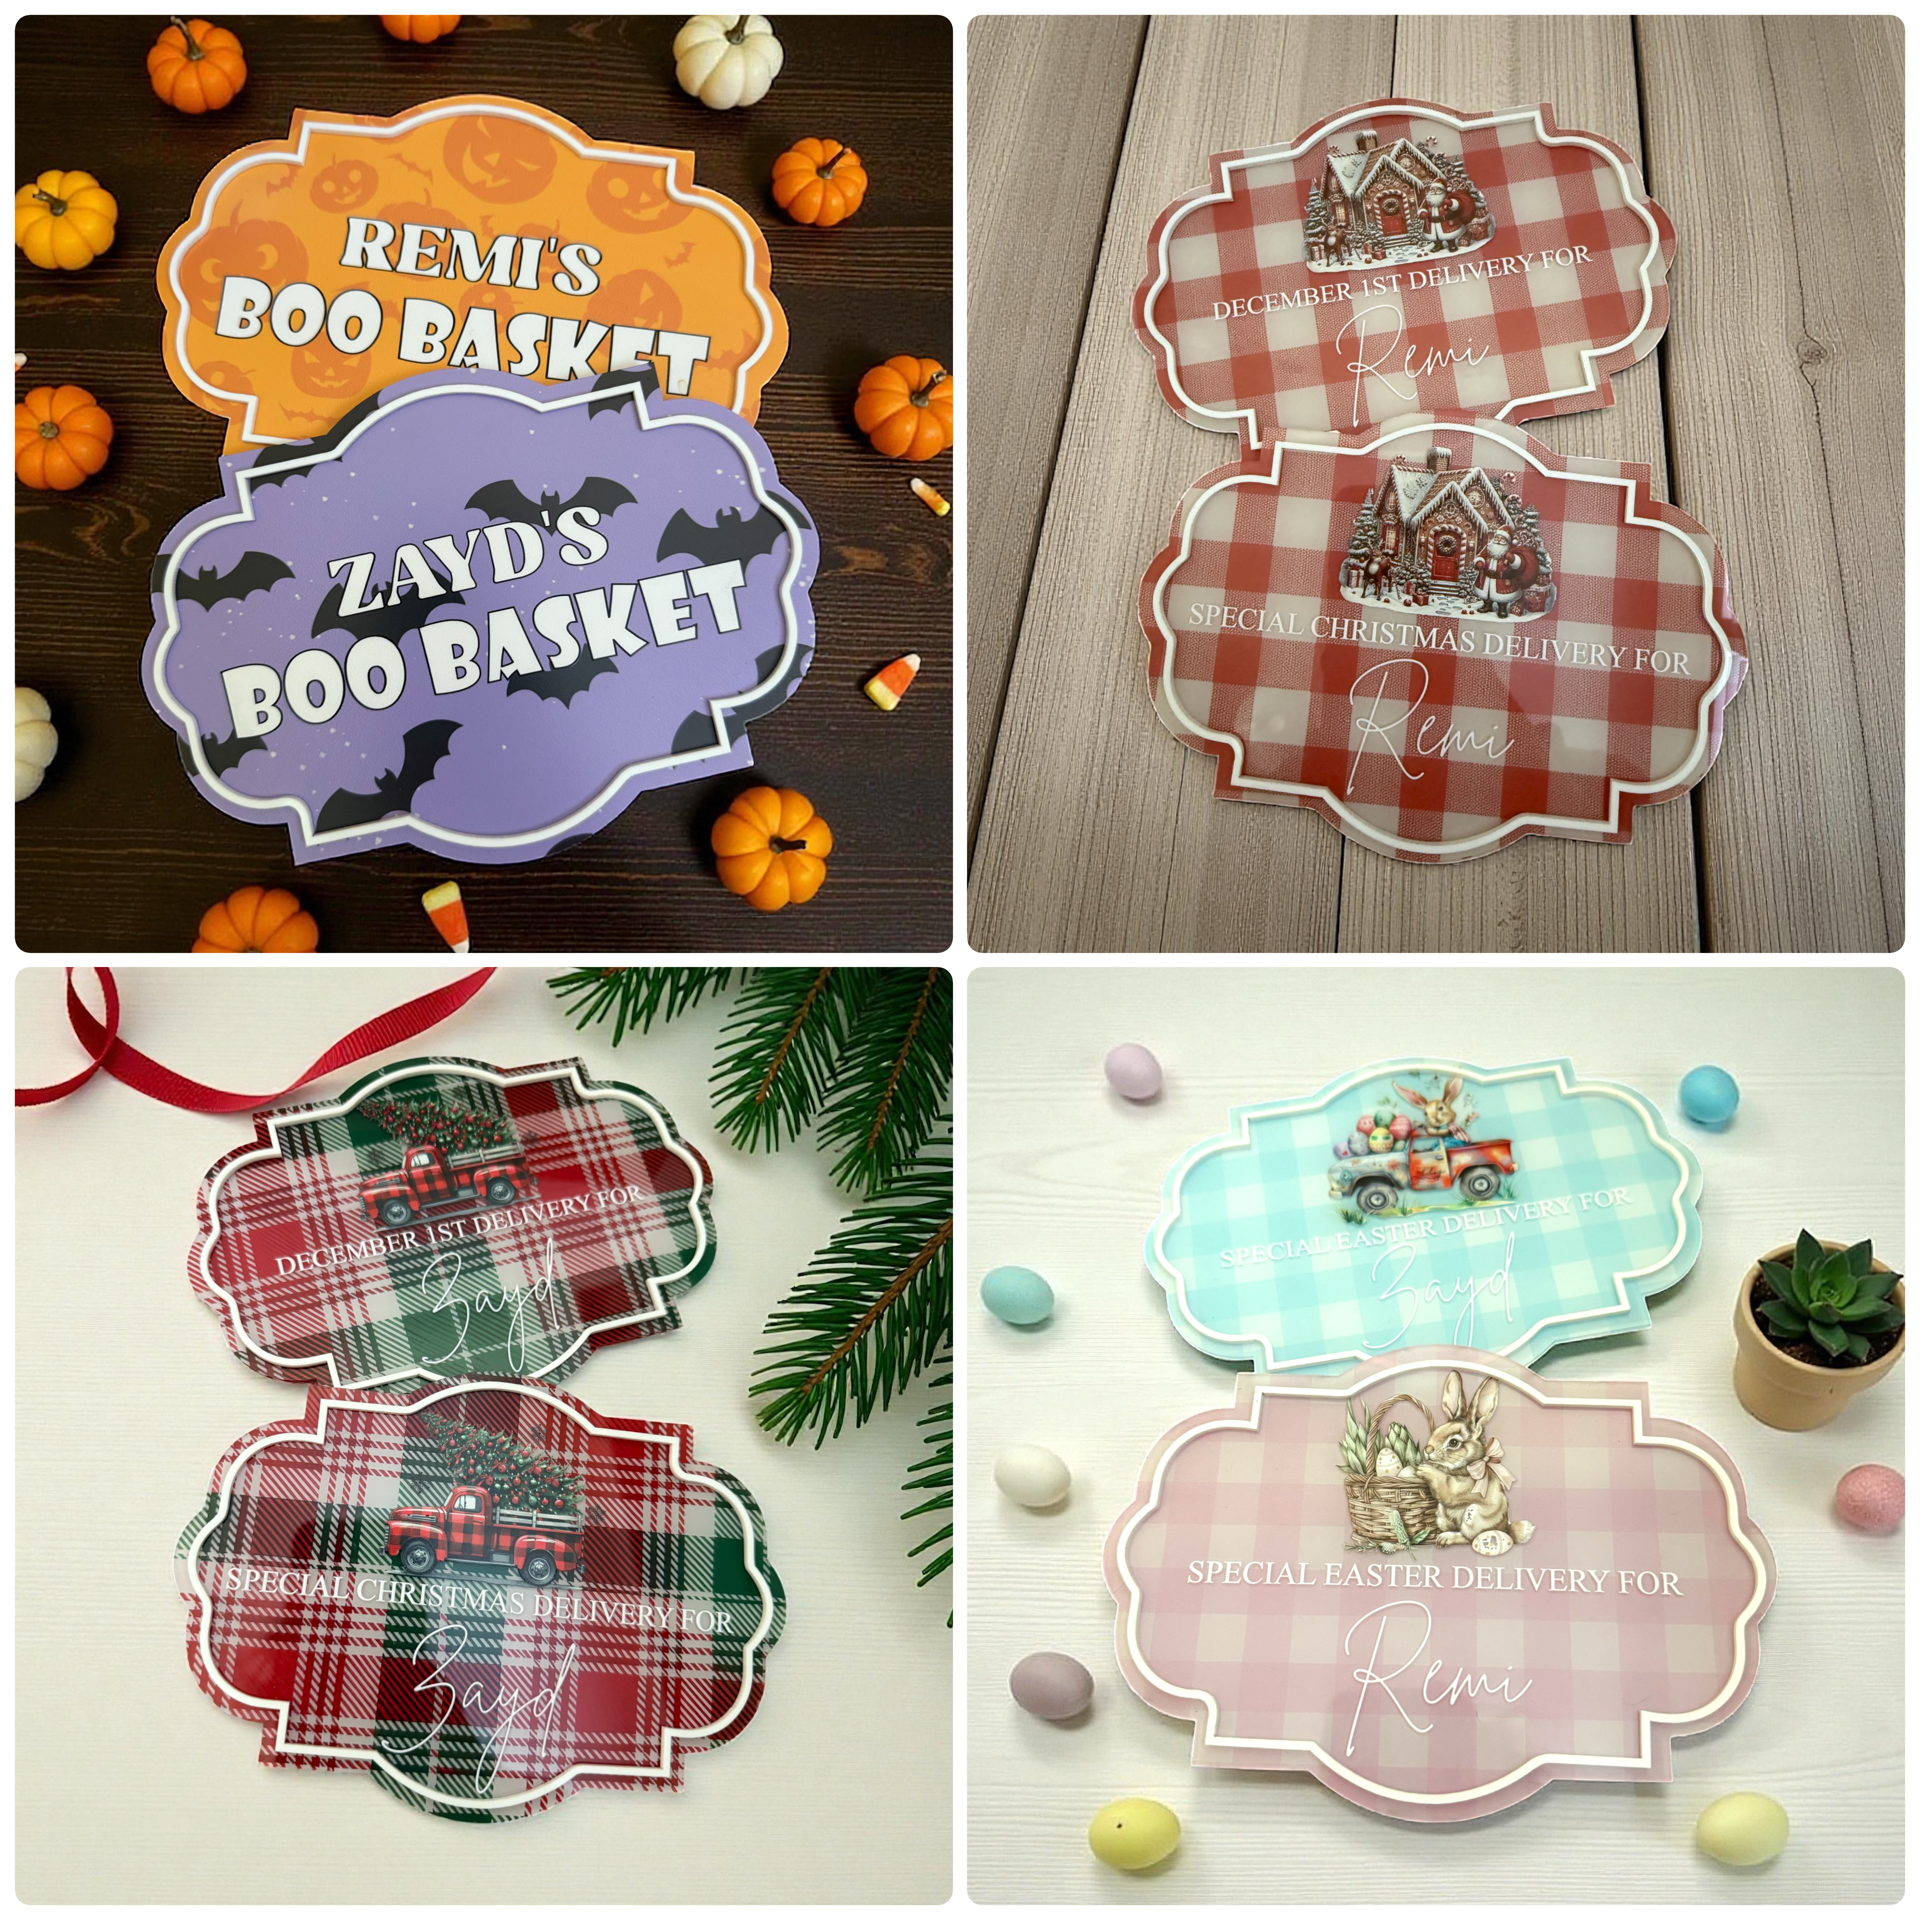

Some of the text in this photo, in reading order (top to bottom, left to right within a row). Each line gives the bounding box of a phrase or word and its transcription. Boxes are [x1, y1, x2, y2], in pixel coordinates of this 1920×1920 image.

[339, 216, 603, 297] REMI'S
[1212, 245, 1592, 320] DECEMBER 1ST DELIVERY FOR
[215, 275, 383, 355] BOO
[1336, 304, 1489, 427] Remi
[327, 505, 609, 618] ZAYD'S
[221, 558, 746, 739] BOO BASKET
[1189, 603, 1691, 676] SPECIAL CHRISTMAS DELIVERY FOR
[1347, 658, 1515, 796] Remi
[275, 1185, 644, 1277] DECEMBER 1ST DELIVERY FOR
[1219, 1188, 1632, 1269] SPECIAL EASTER DELIVERY FOR
[225, 1568, 734, 1635] SPECIAL CHRISTMAS DELIVERY FOR
[1187, 1560, 1684, 1596] SPECIAL EASTER DELIVERY FOR
[1344, 1600, 1533, 1757] Remi
